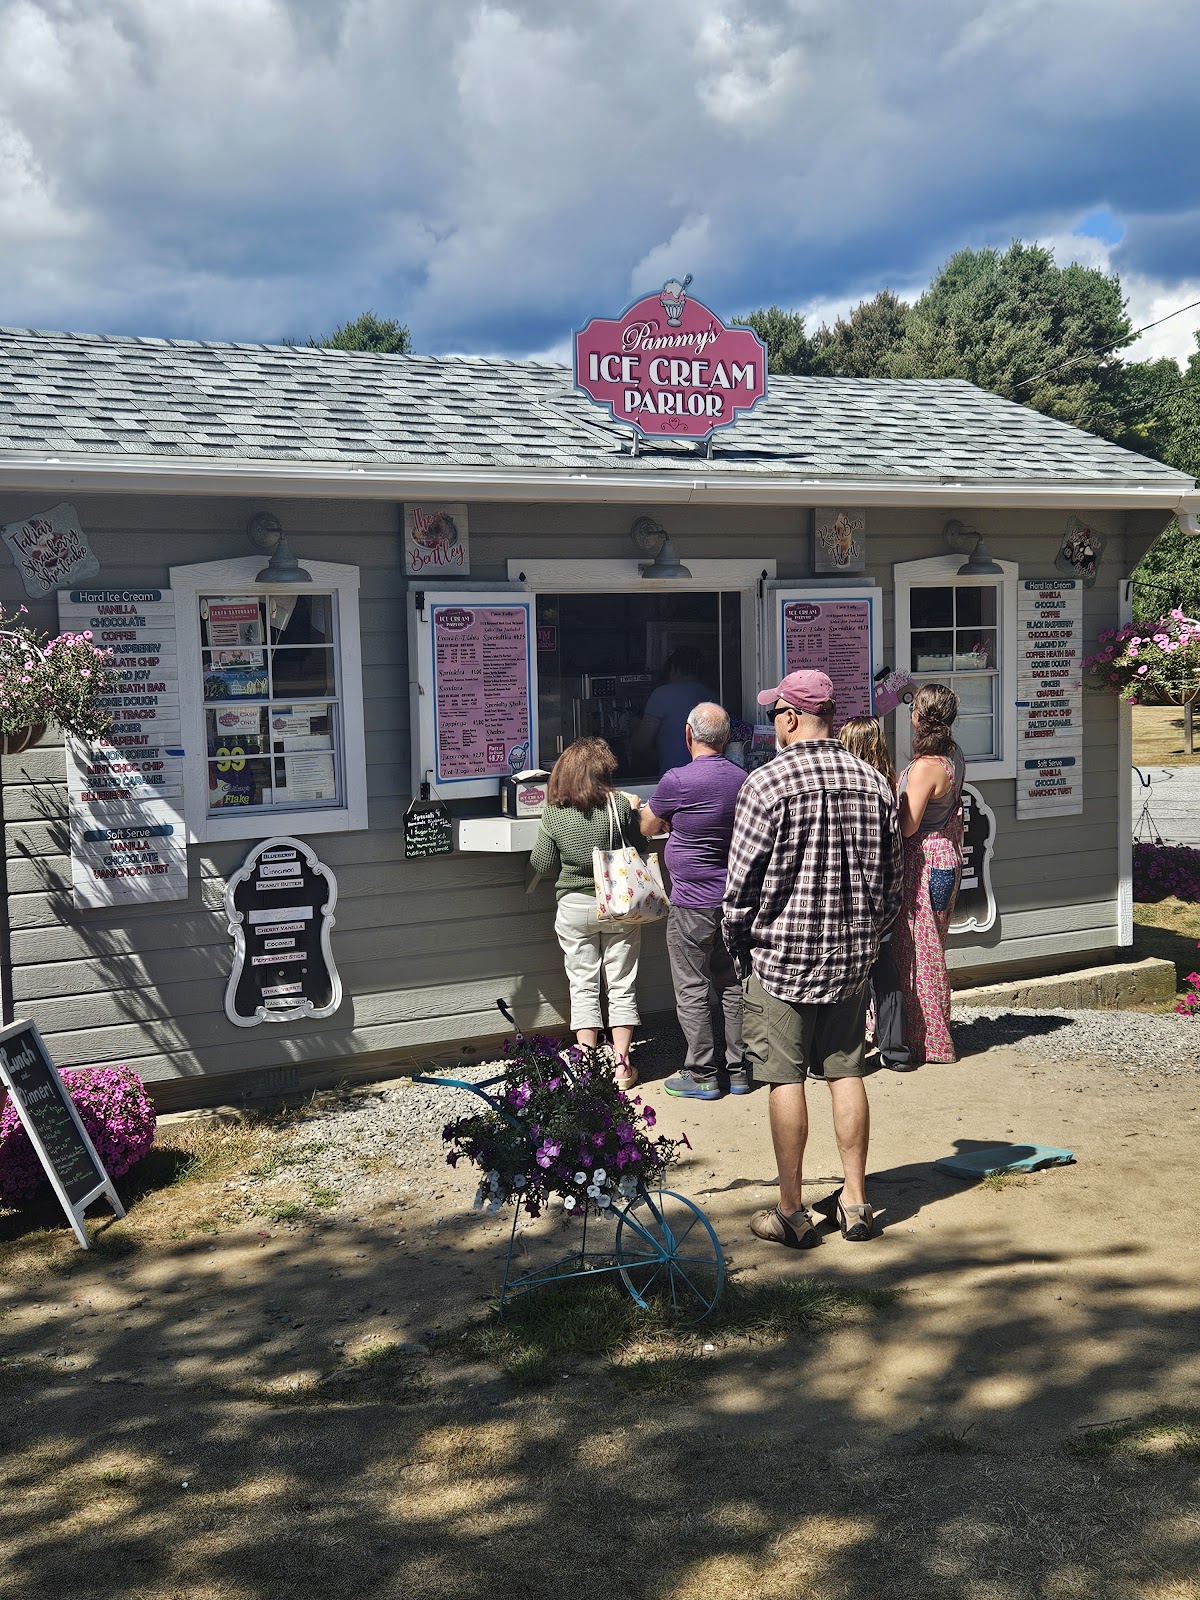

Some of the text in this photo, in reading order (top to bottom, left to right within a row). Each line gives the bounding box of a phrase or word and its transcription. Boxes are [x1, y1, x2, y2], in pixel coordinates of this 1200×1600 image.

[621, 320, 723, 355] Pammy's
[588, 353, 756, 391] ICE CREAM
[623, 389, 723, 418] PARLOR
[9, 519, 53, 557] Talia's
[21, 528, 80, 579] Strawberry
[37, 545, 87, 591] Shortcake
[1029, 581, 1044, 589] Hard
[1053, 581, 1072, 589] Cream
[79, 591, 154, 602] Hard Ice Cream
[1039, 591, 1061, 599] VANILLA
[97, 605, 137, 615] VANILLA
[90, 617, 146, 628] CHOCOLATE
[1026, 620, 1074, 629] BLACK RASPBERRY
[101, 631, 137, 641] COFFEE
[1028, 630, 1073, 639] CHOCOLATE CHIP
[1034, 640, 1068, 649] ALMOND JOY
[1025, 649, 1076, 659] COFFEE HEATH BAR
[138, 657, 160, 667] CHIP
[1051, 660, 1071, 668] DOUGH
[134, 670, 151, 680] JOY
[1050, 669, 1069, 678] TRACKS
[147, 682, 166, 692] BAR
[124, 695, 158, 706] DOUGH
[1030, 700, 1070, 708] LEMON SORBET
[122, 709, 156, 719] TRACKS
[1028, 710, 1043, 718] MINT
[1059, 708, 1072, 717] CHIP
[1028, 720, 1048, 729] SALTED
[1024, 729, 1055, 739] BLUEBERRY
[125, 748, 160, 759] SORBET
[216, 746, 246, 772] 99
[1037, 759, 1063, 768] Soft Serve
[87, 764, 109, 774] MINT
[142, 761, 164, 772] CHIP
[1039, 769, 1062, 777] VANILLA
[87, 776, 121, 788] SALTED
[1035, 778, 1067, 787] CHOCOLATE
[81, 789, 132, 802] BLUEBERRY
[1057, 787, 1073, 796] TWIST
[224, 793, 250, 804] Flake
[106, 828, 151, 840] Soft Serve
[110, 840, 150, 852] VANILLA
[103, 852, 158, 866] CHOCOLATE
[143, 864, 170, 875] TWIST
[262, 866, 295, 875] Cinnamon
[0, 1039, 37, 1073] Lunch
